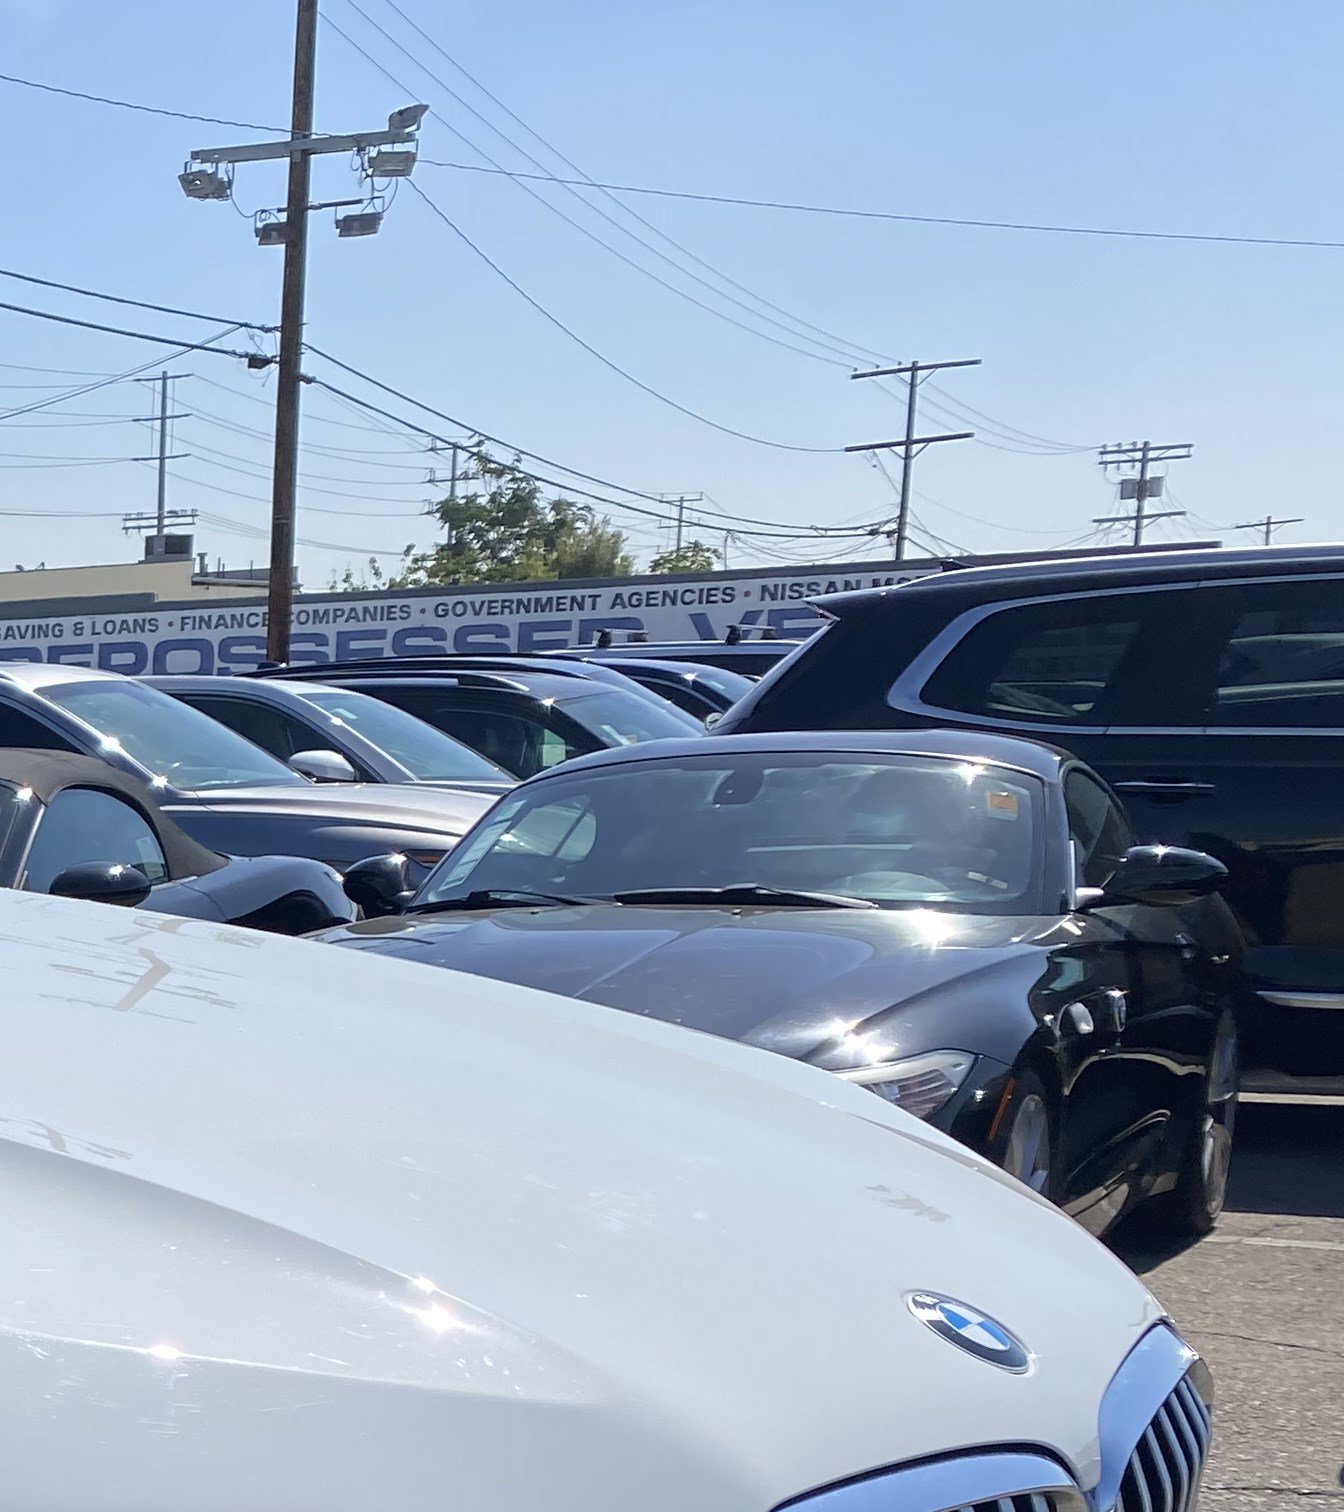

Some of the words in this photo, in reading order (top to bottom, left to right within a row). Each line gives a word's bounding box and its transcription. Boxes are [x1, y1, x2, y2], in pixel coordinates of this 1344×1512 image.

[72, 621, 85, 637] &
[91, 617, 160, 636] LOANS
[433, 594, 602, 618] GOVERNMENT
[609, 583, 737, 610] AGENCIES
